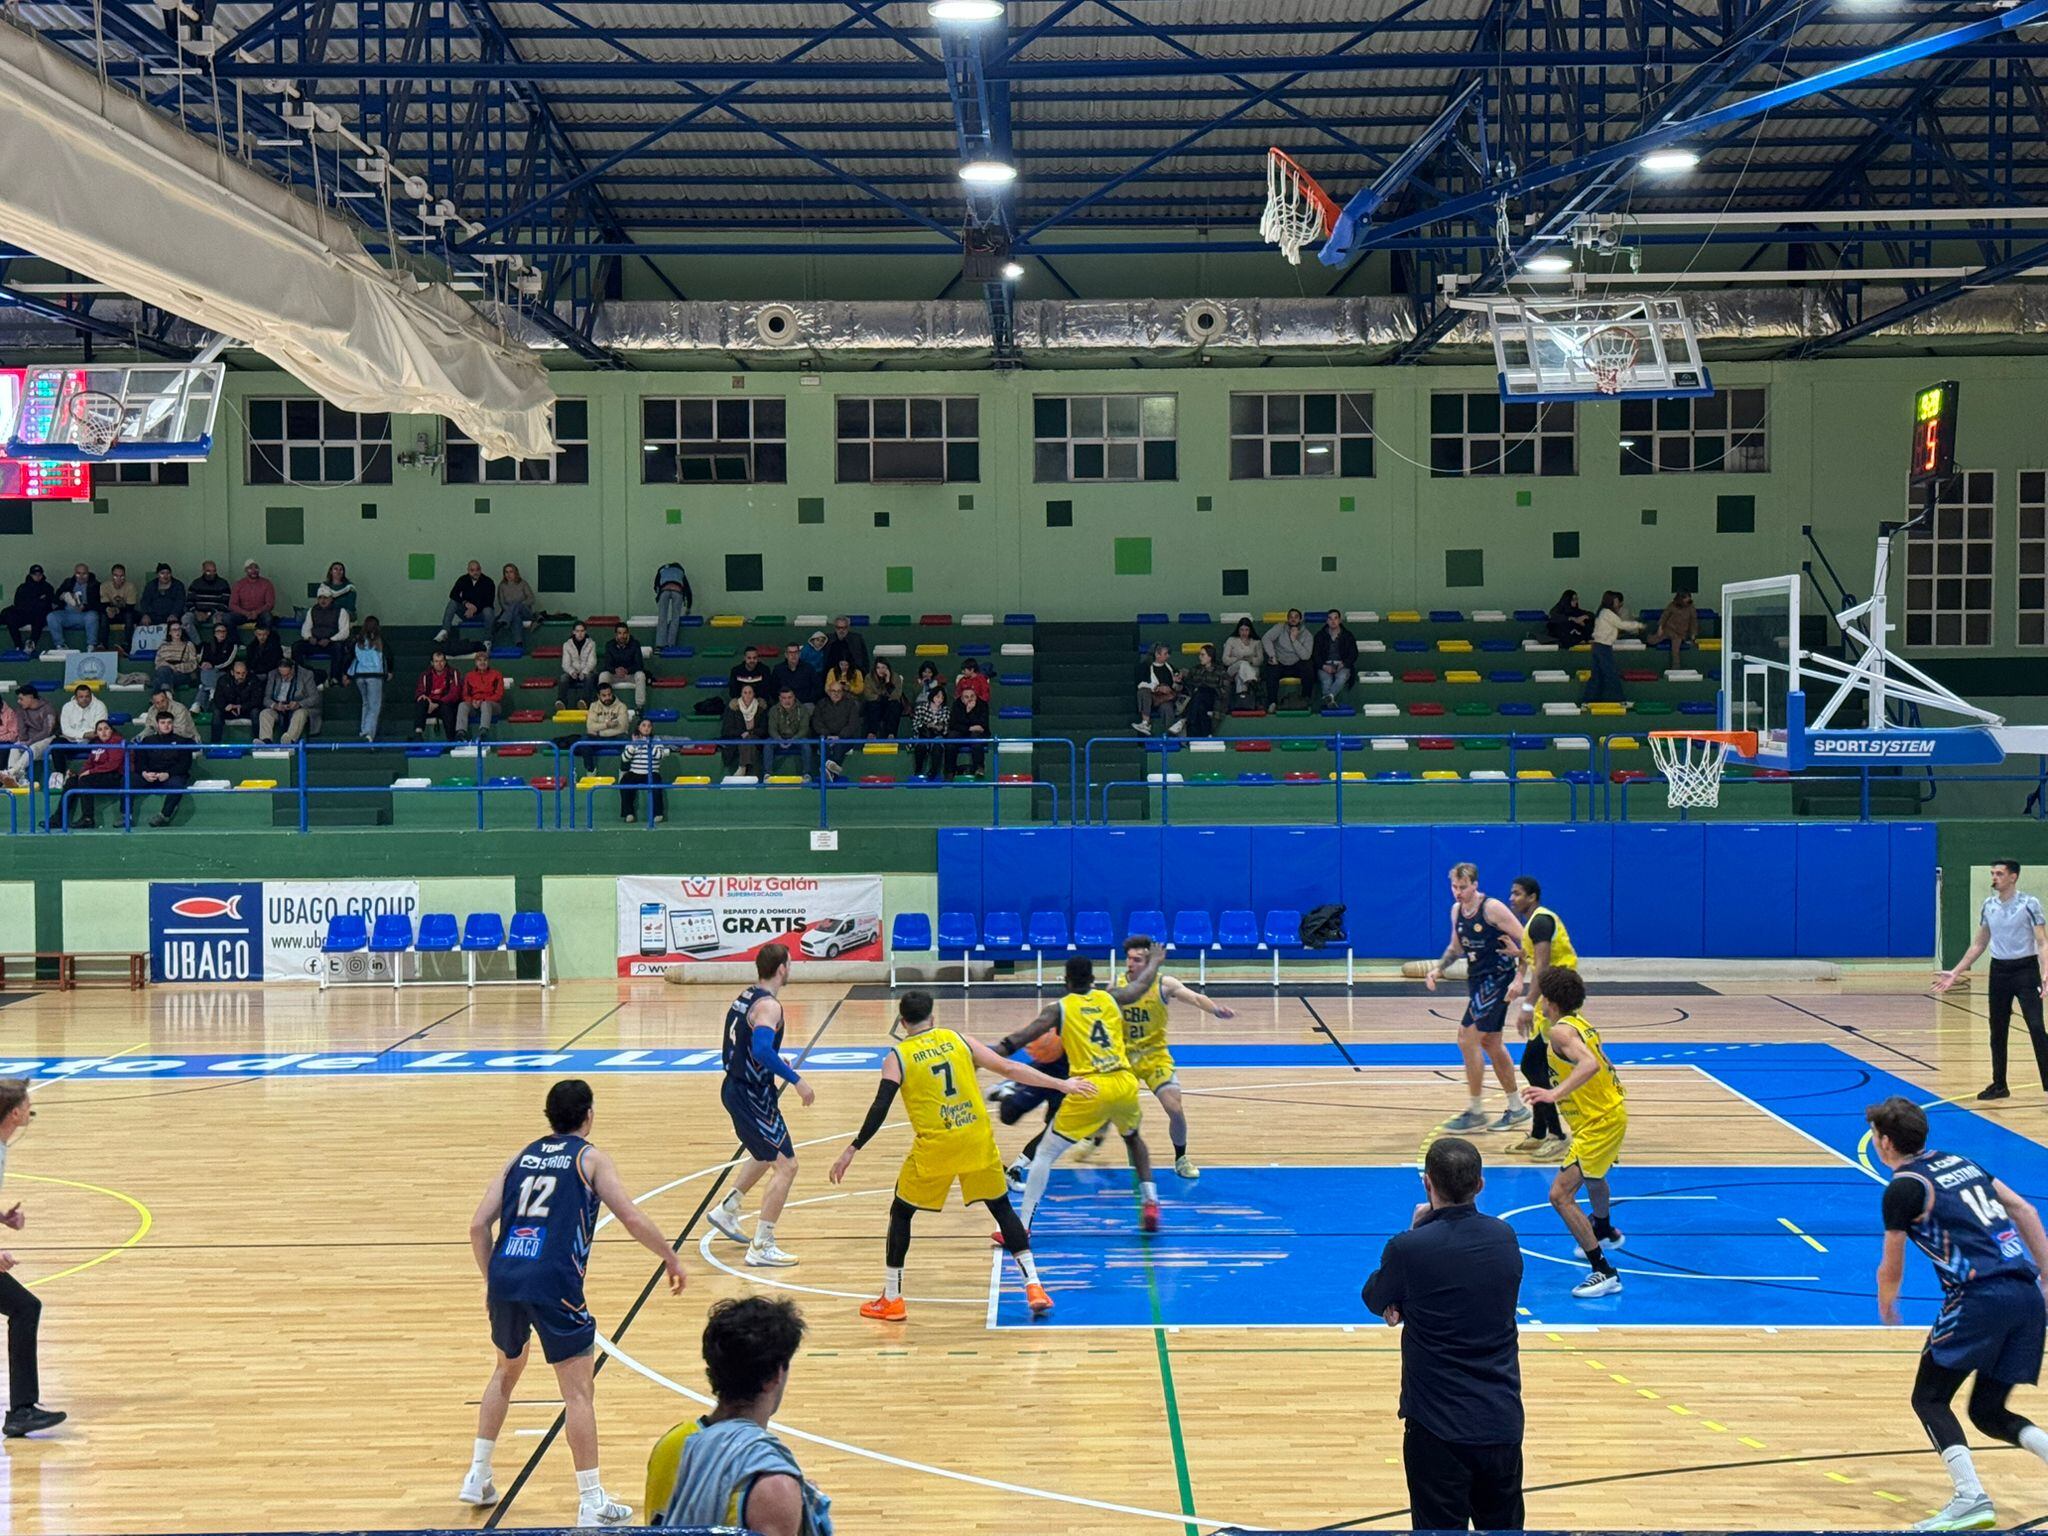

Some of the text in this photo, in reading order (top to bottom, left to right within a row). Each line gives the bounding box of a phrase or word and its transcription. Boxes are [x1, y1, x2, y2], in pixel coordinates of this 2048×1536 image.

[726, 877, 818, 891] Ruiz Galán
[269, 897, 416, 924] UBAGO GROUP
[722, 917, 807, 934] GRATIS
[163, 940, 250, 980] UBAGO
[1089, 1020, 1111, 1048] 4
[207, 1053, 378, 1071] de
[402, 1052, 574, 1067] La
[912, 1042, 954, 1063] ARTILES
[931, 1061, 957, 1097] 7
[517, 1175, 557, 1218] 12
[1959, 1185, 2009, 1227] 14
